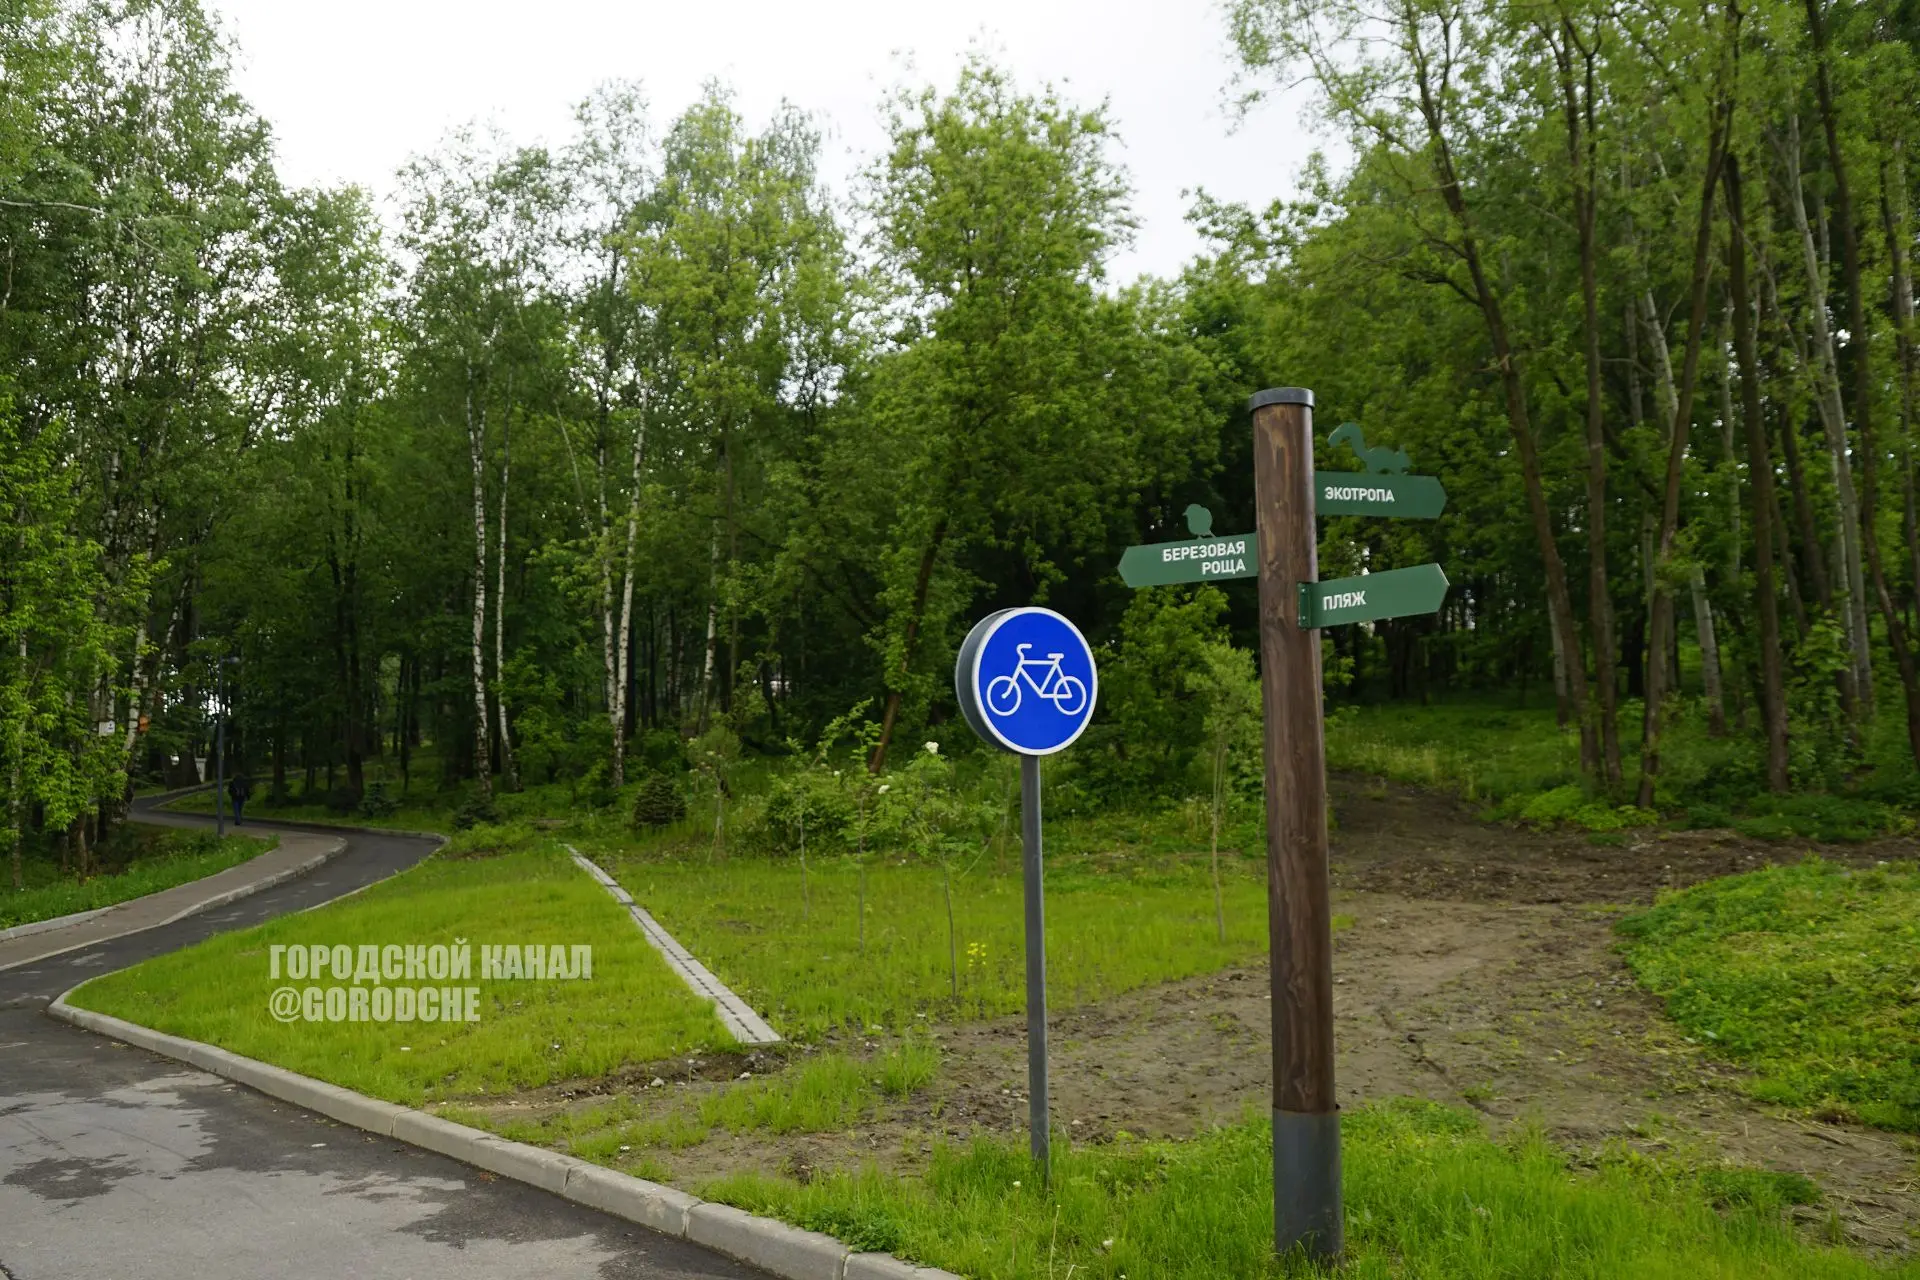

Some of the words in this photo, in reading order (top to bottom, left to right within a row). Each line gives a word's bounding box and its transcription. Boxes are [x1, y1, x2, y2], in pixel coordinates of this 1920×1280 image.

[1324, 486, 1395, 503] ЭКОТРОПА
[1162, 540, 1246, 563] БЕРЕЗОВАЯ
[1201, 558, 1246, 575] РОЩА
[1322, 590, 1367, 611] ПЛЯЖ
